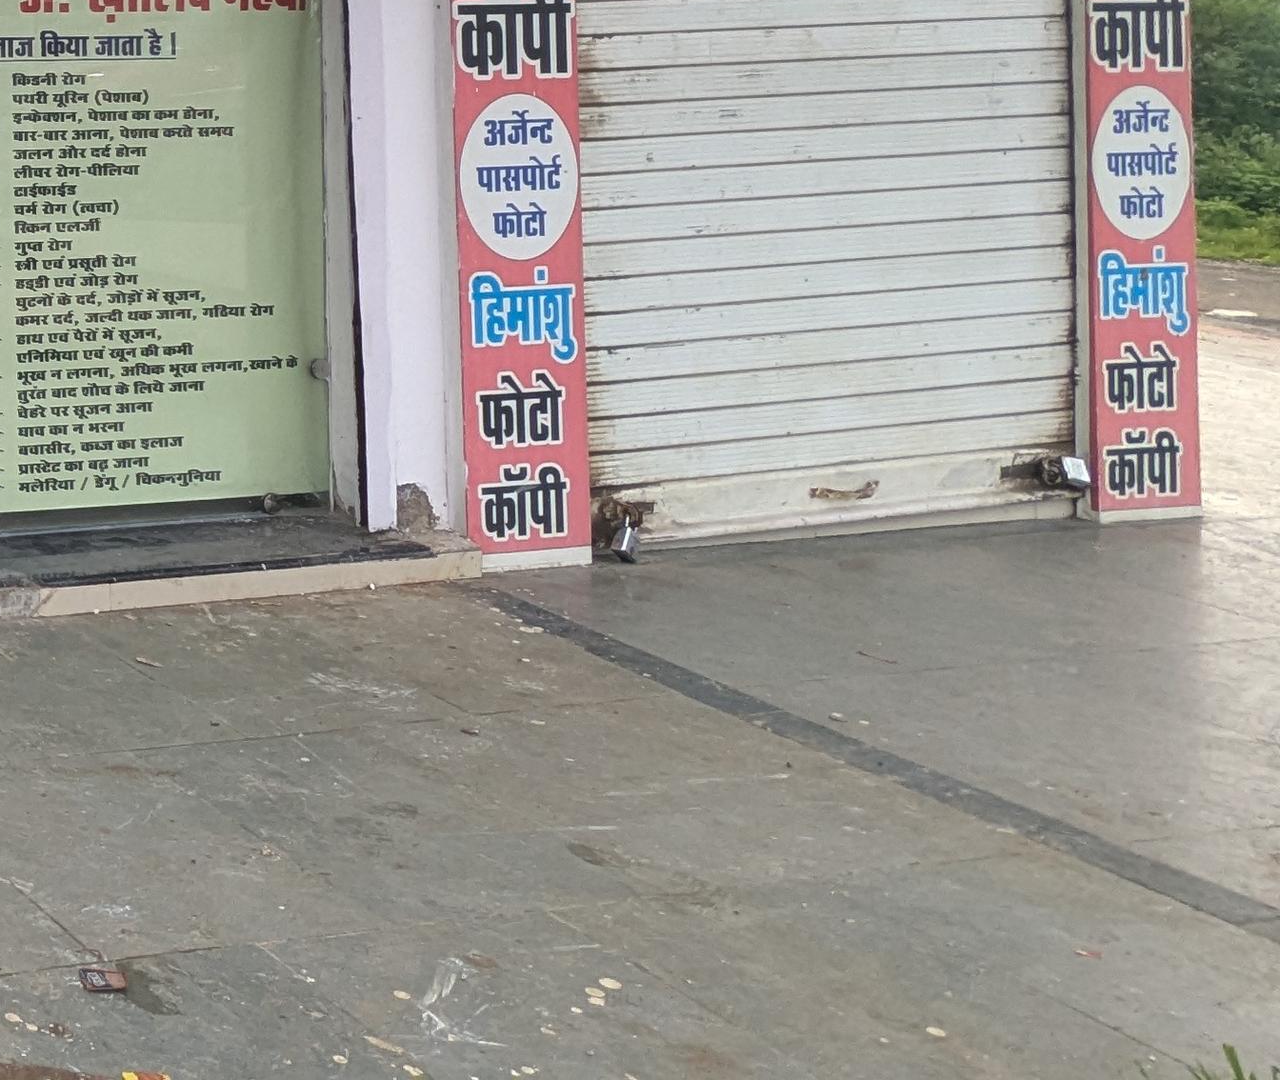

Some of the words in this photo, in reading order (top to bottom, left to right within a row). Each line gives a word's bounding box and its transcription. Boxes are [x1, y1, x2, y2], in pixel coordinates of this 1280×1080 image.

[40, 31, 88, 57] किया
[95, 35, 142, 57] जाता
[12, 72, 58, 86] किडनी
[61, 72, 86, 85] रोग
[484, 110, 553, 147] अर्जेन्ट
[1113, 101, 1169, 135] अर्जेन्ट
[476, 154, 561, 193] पासपोर्ट
[1107, 143, 1177, 177] पासपोर्ट
[13, 201, 38, 215] चर्म
[41, 201, 67, 215] रोग
[493, 202, 546, 238] फोटो
[1120, 186, 1164, 219] फोटो
[47, 238, 73, 251] रोग
[1100, 247, 1187, 333] हिमांशु
[470, 269, 575, 361] हिमांशु
[1106, 346, 1177, 410] फोटो
[480, 374, 563, 446] फोटो
[1106, 431, 1180, 496] कॉपी
[18, 478, 76, 493] मलेरिया
[482, 466, 567, 538] कॉपी
